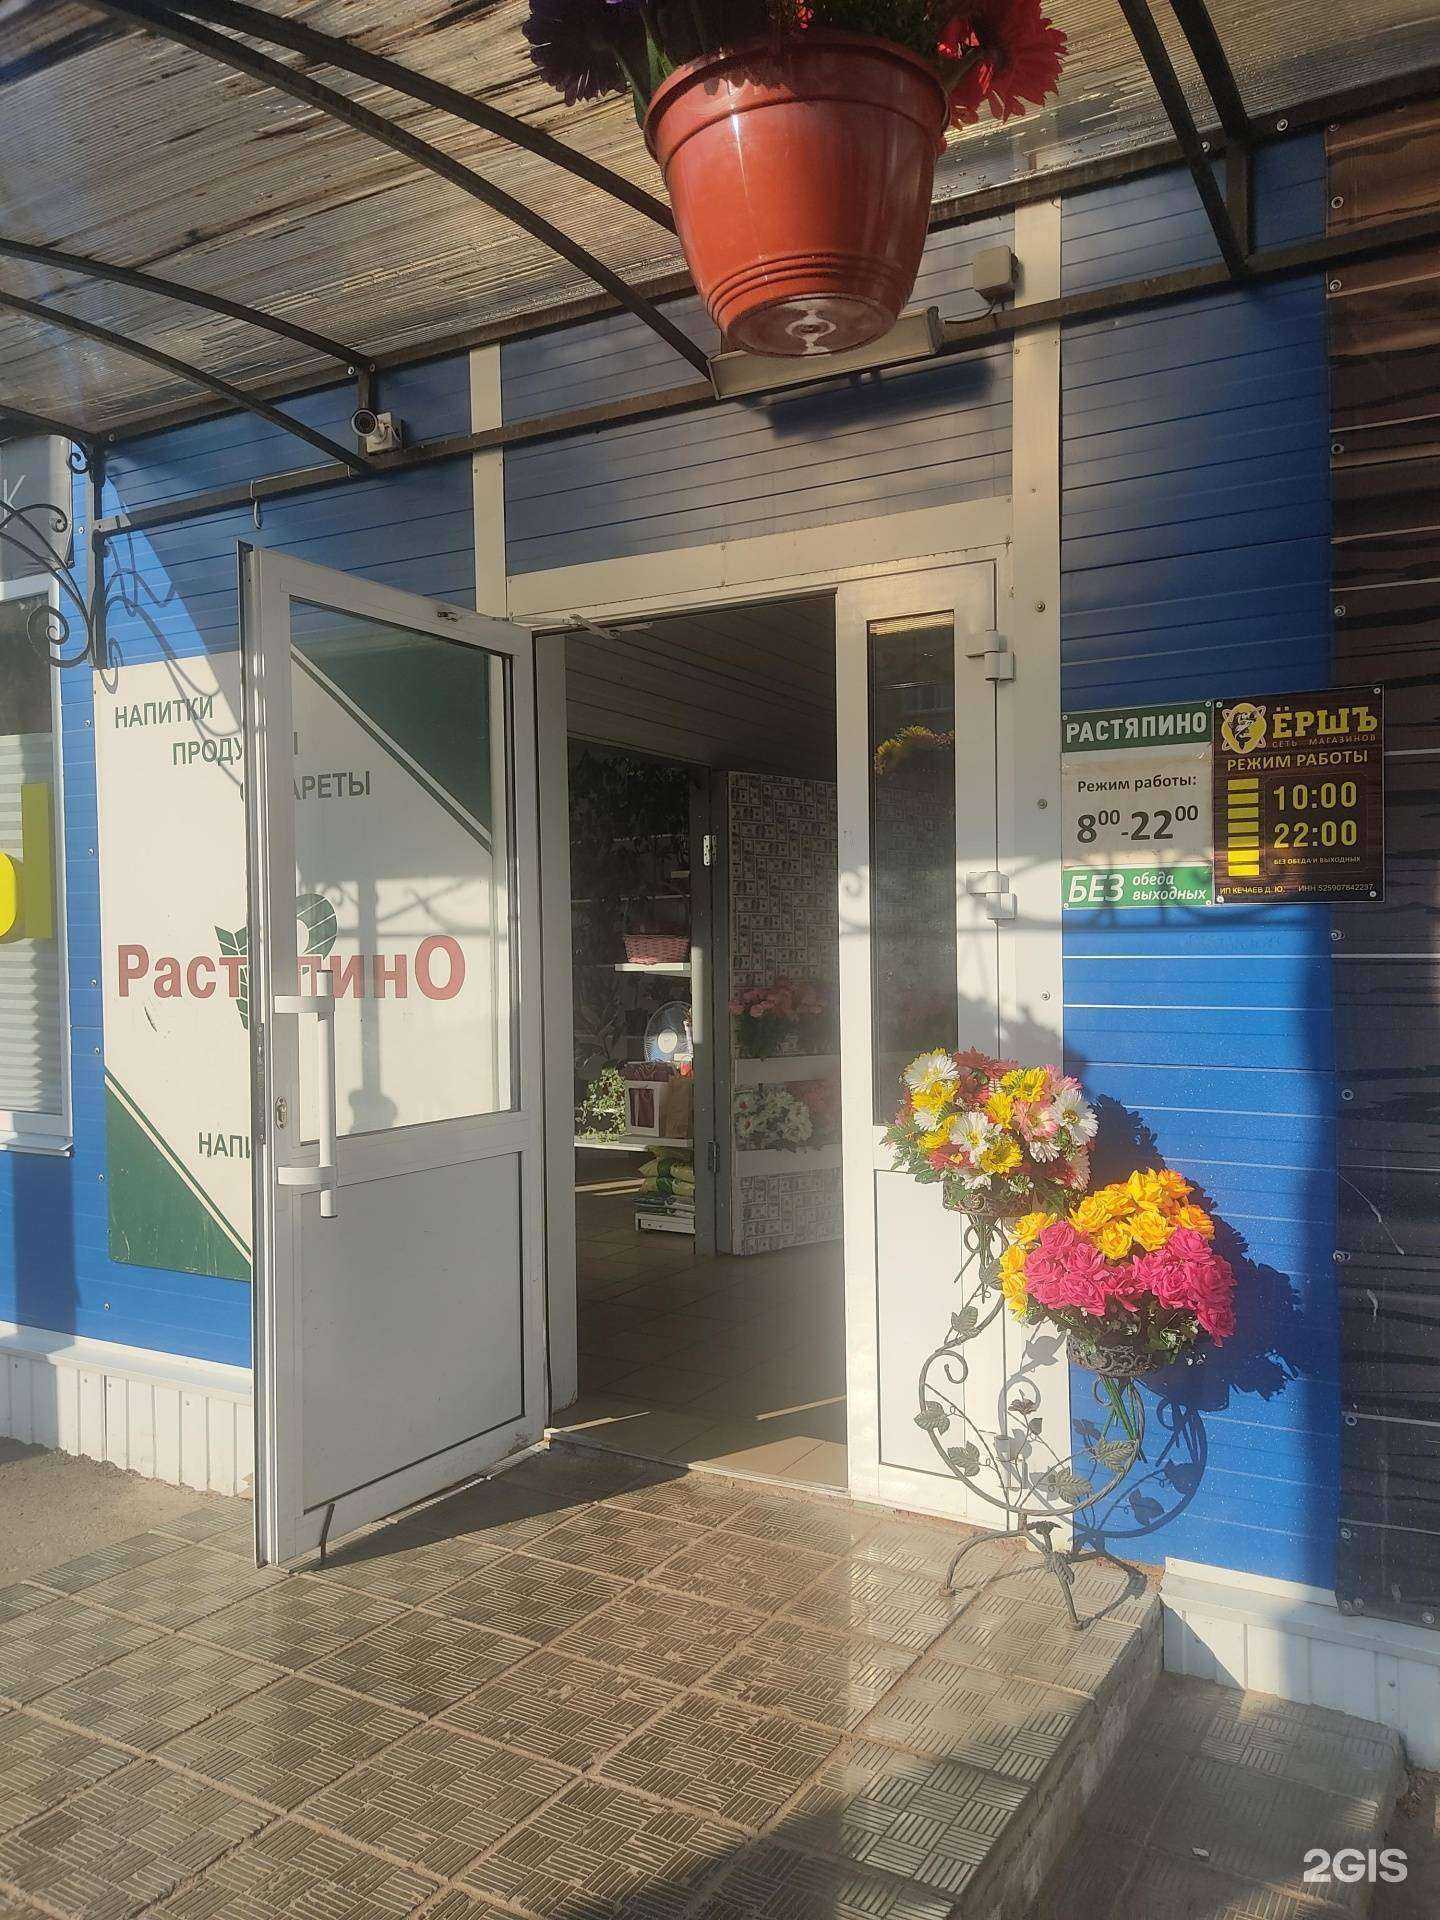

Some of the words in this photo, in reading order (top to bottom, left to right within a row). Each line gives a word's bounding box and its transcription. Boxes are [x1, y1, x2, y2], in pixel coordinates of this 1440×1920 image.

[115, 696, 214, 729] НАПИТКИ
[1272, 706, 1378, 739] ЁРШЪ
[1066, 711, 1207, 744] РАСТЯПИНО
[1272, 740, 1298, 749] СЕТЬ
[1309, 734, 1376, 746] МАГАЗИНОВ
[1227, 755, 1291, 772] РЕЖИМ
[1297, 750, 1368, 767] РАБОТЫ
[1077, 780, 1130, 793] Режим
[1134, 774, 1197, 792] работы:
[1273, 781, 1357, 811] 10:00
[1273, 820, 1357, 848] 22:00
[1068, 873, 1125, 903] БЕЗ
[1132, 871, 1174, 886] обеда
[1298, 884, 1316, 892] ИНН
[1133, 885, 1207, 901] выходных
[117, 935, 466, 1000] РастпинО
